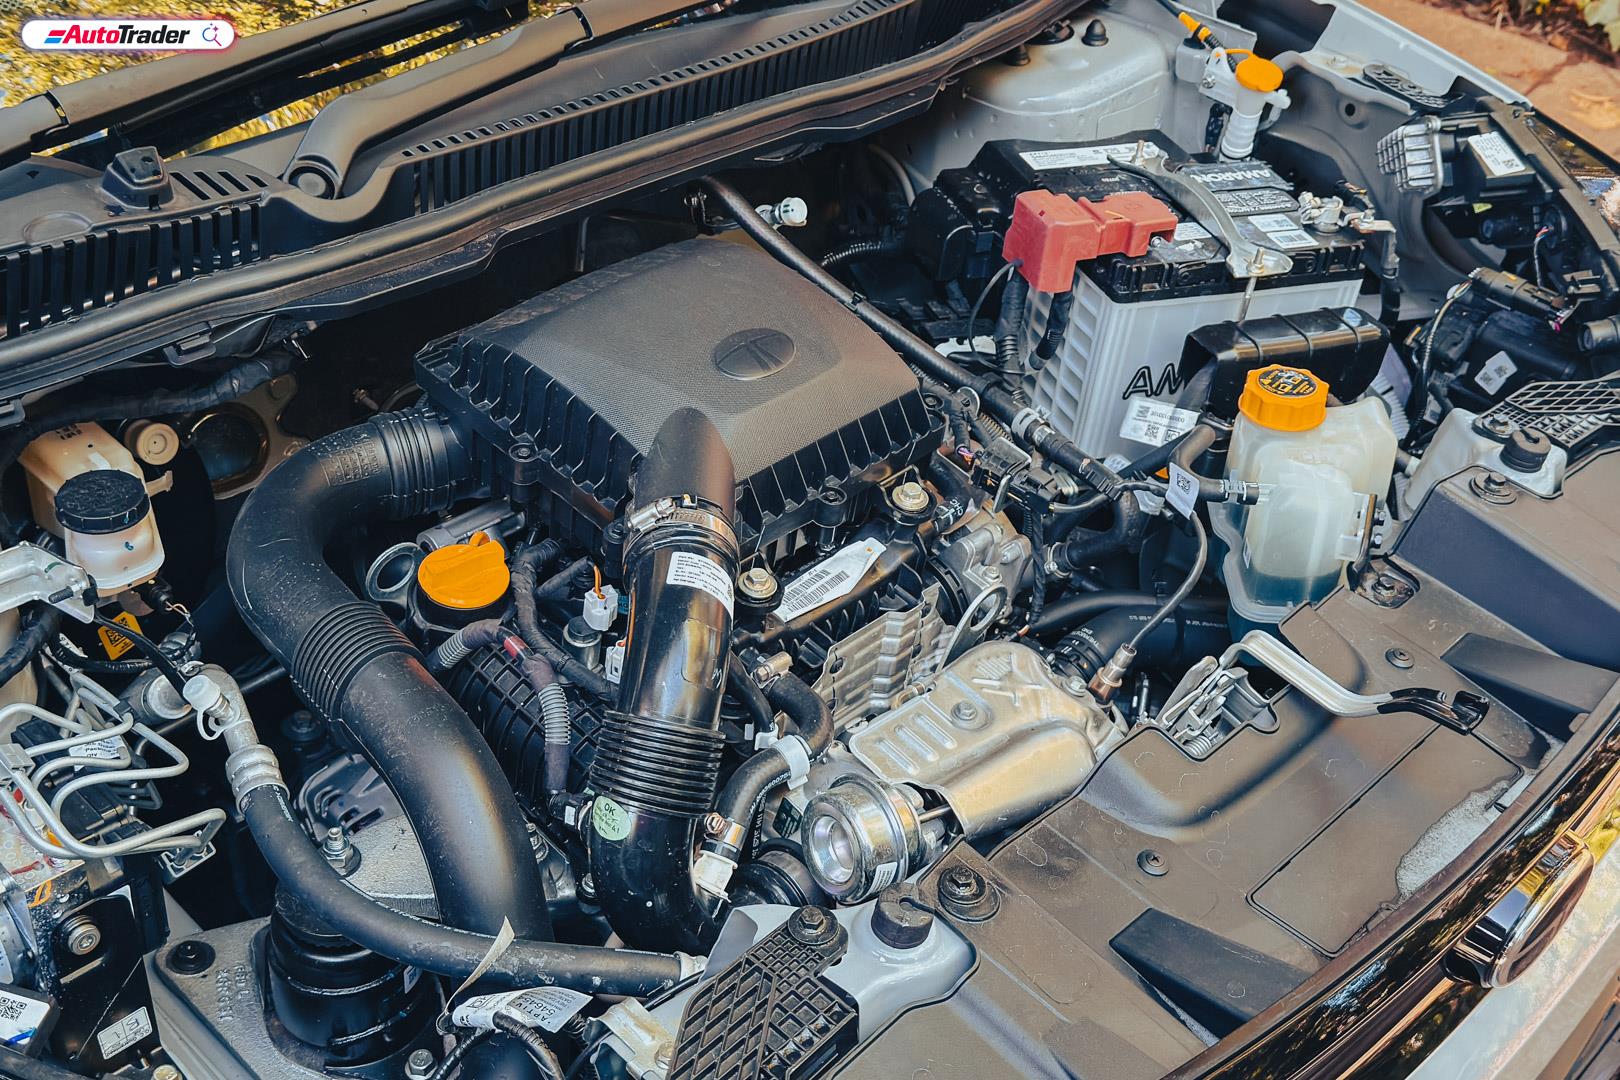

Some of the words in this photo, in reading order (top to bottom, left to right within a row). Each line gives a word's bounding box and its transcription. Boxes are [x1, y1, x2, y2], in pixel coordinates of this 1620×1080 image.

[1190, 169, 1271, 183] AMARON
[604, 803, 616, 816] OK
[515, 1002, 547, 1022] APTIV
